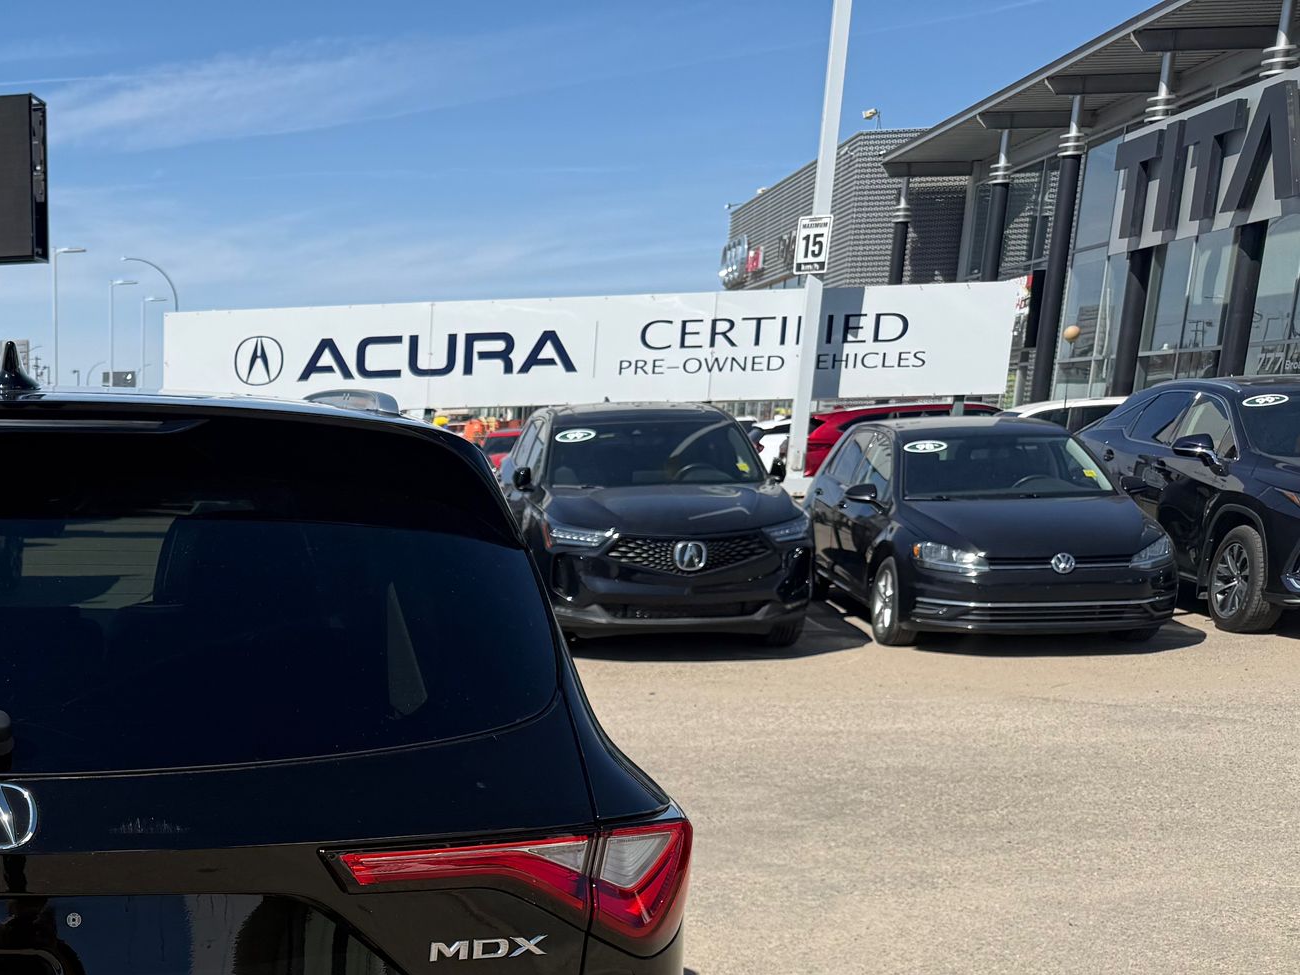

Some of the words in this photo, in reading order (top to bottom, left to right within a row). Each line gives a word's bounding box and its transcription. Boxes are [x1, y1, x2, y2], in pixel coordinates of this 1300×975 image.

[802, 233, 824, 258] 15
[297, 330, 577, 381] ACURA
[618, 354, 785, 375] PRE-OWNED
[815, 351, 926, 370] EHICLES
[430, 935, 548, 962] MDX
